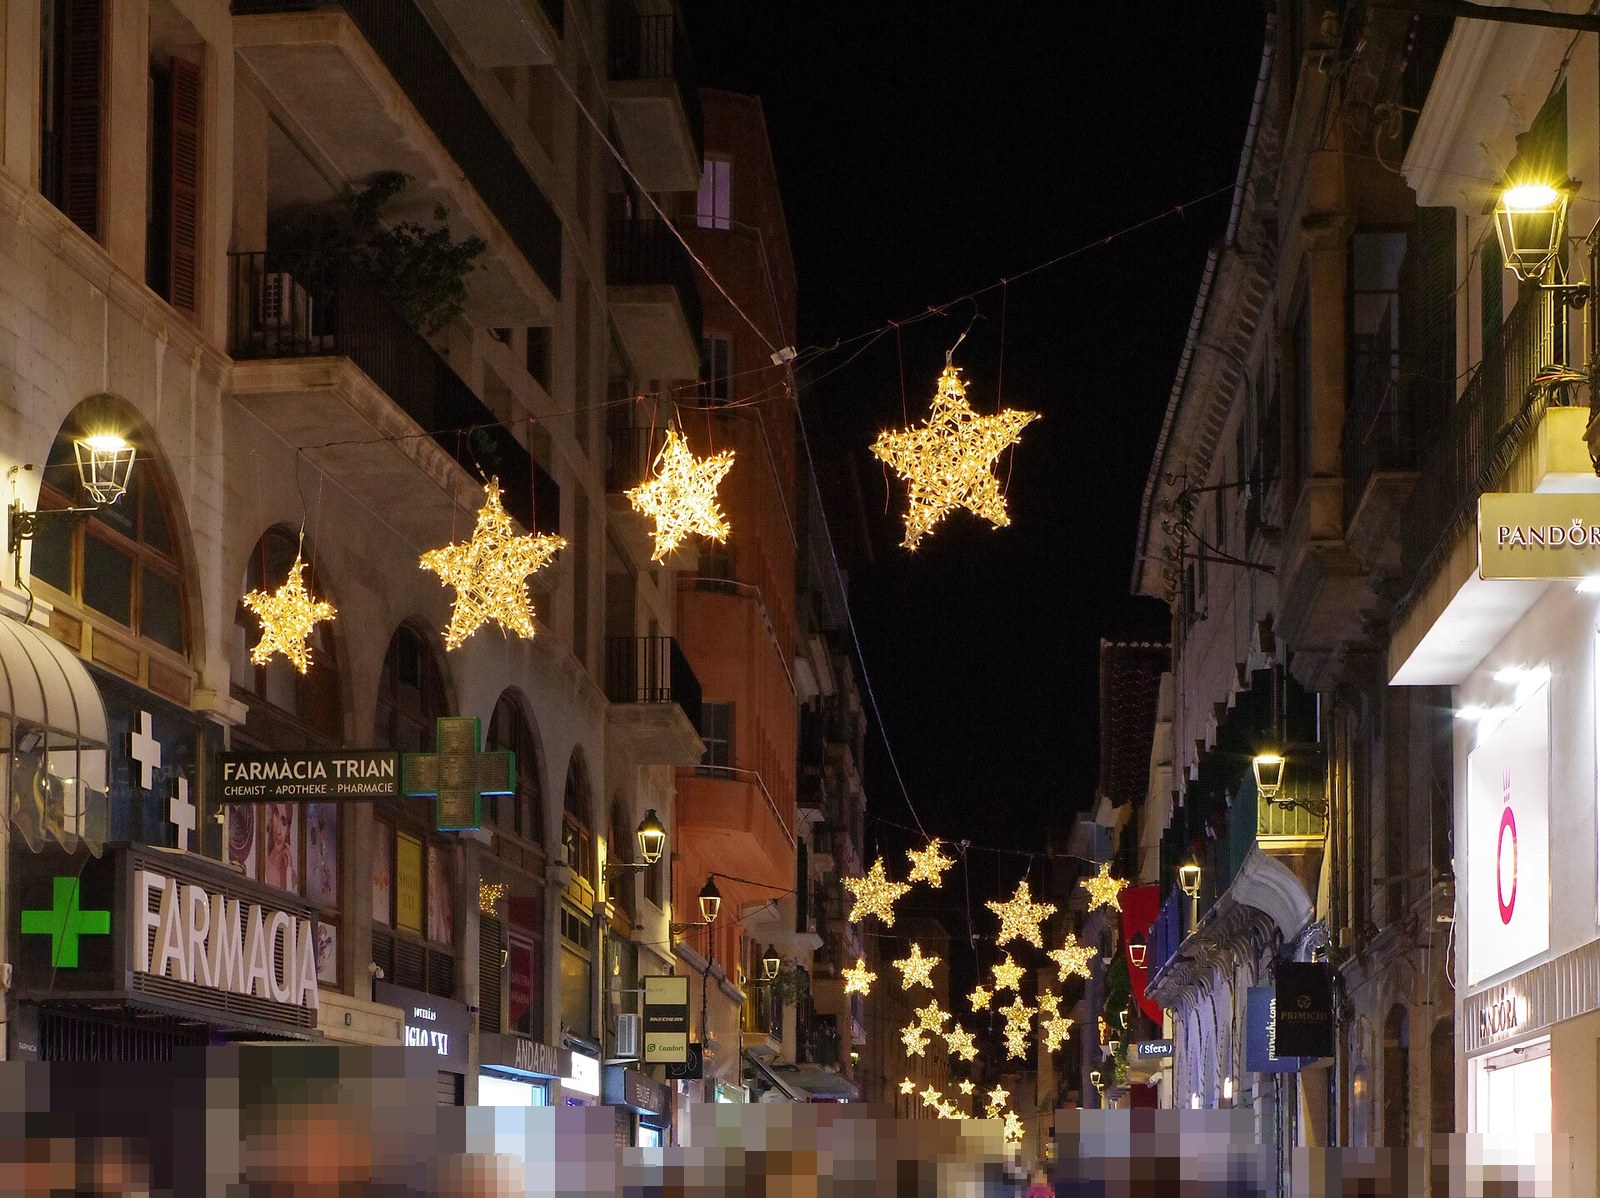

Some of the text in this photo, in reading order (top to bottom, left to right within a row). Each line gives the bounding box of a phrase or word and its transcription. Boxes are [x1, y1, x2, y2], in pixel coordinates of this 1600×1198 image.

[1498, 519, 1600, 545] PANDOR
[224, 758, 394, 780] FARMÀCIA TRIAN
[224, 785, 266, 796] CHEMIST
[275, 784, 327, 795] APOTHEKE
[337, 783, 394, 793] PHARMACIE
[134, 870, 320, 1009] FARMACIA
[1281, 1011, 1328, 1020] PRIMICHI
[404, 1025, 448, 1055] IGLO XXI
